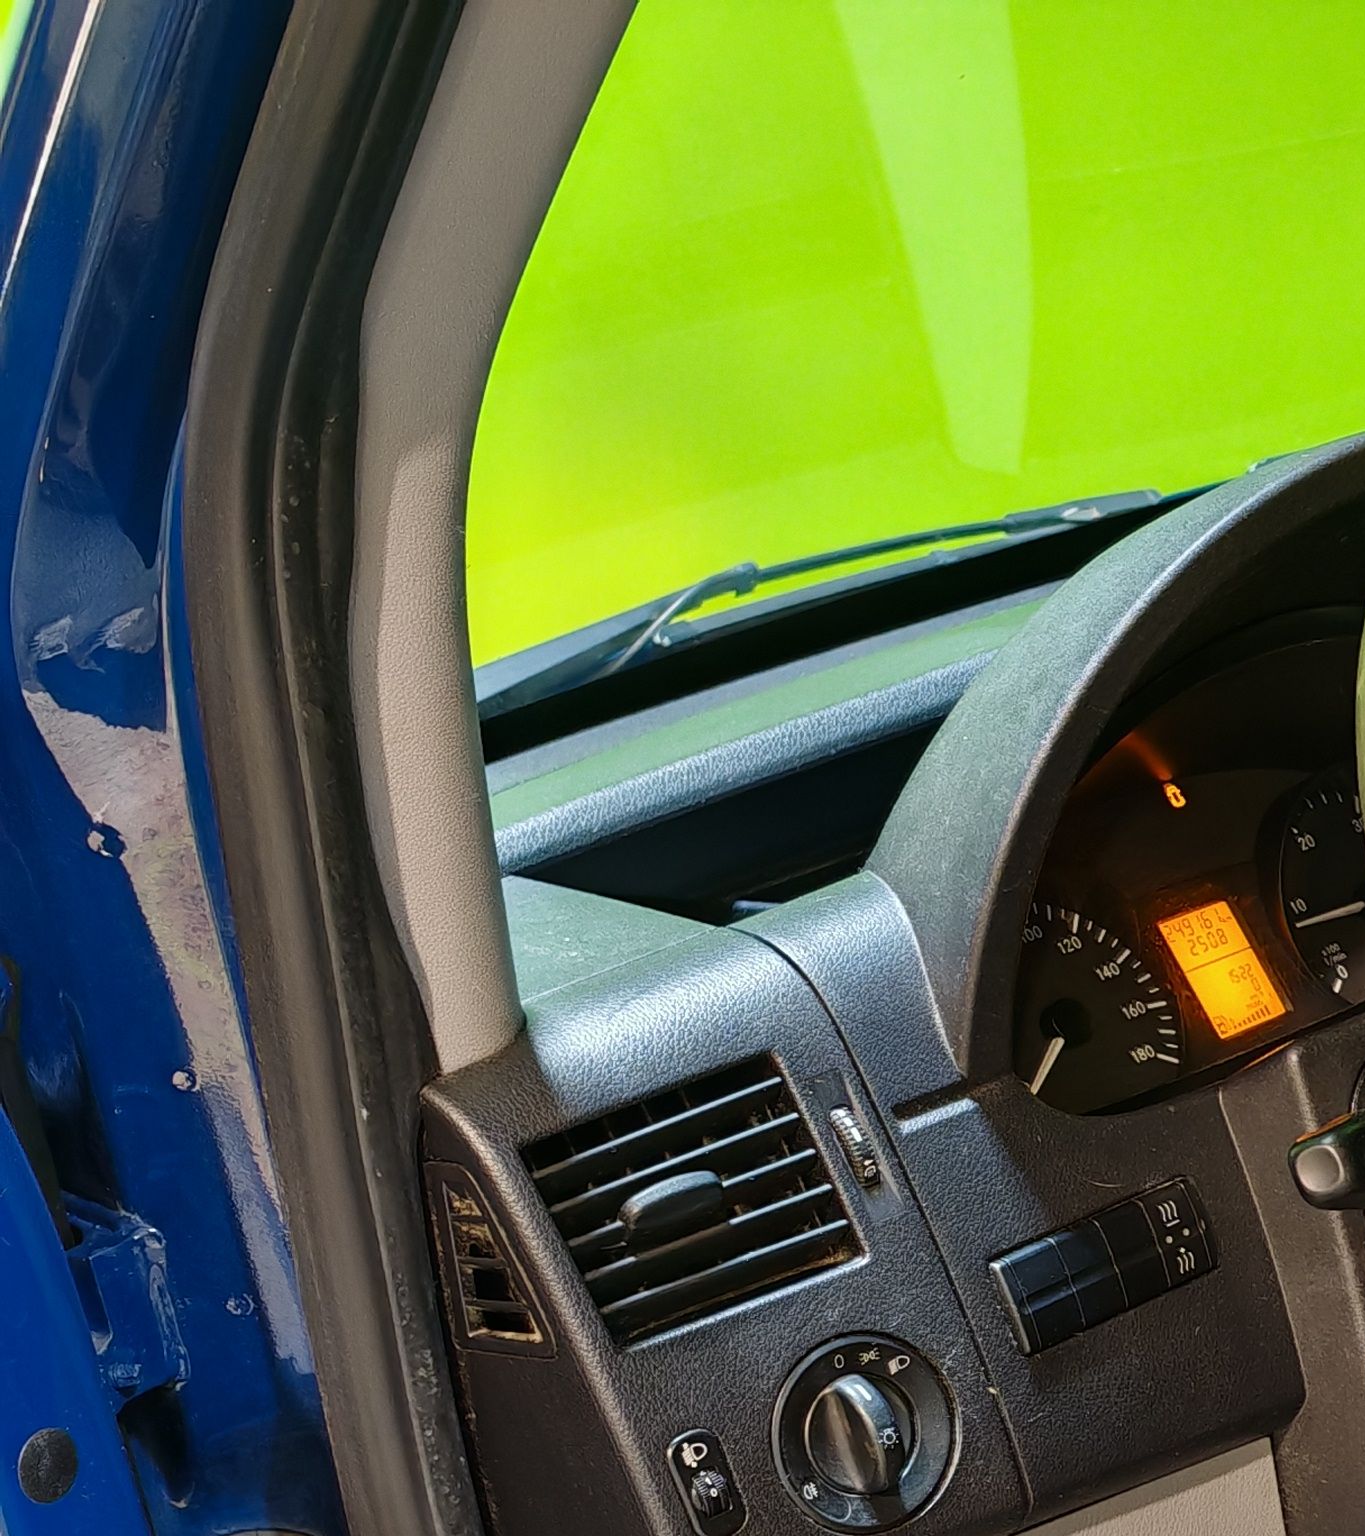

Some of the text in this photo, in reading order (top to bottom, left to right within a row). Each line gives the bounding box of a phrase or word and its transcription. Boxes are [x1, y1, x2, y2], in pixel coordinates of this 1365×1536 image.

[1352, 818, 1363, 833] 3
[1298, 834, 1315, 851] 20
[1290, 898, 1307, 914] 10
[1057, 936, 1082, 954] 120
[1187, 928, 1228, 956] 2508
[1095, 963, 1120, 981] 140
[1336, 965, 1348, 979] 0
[1121, 1001, 1146, 1020] 160
[1130, 1045, 1155, 1063] 180
